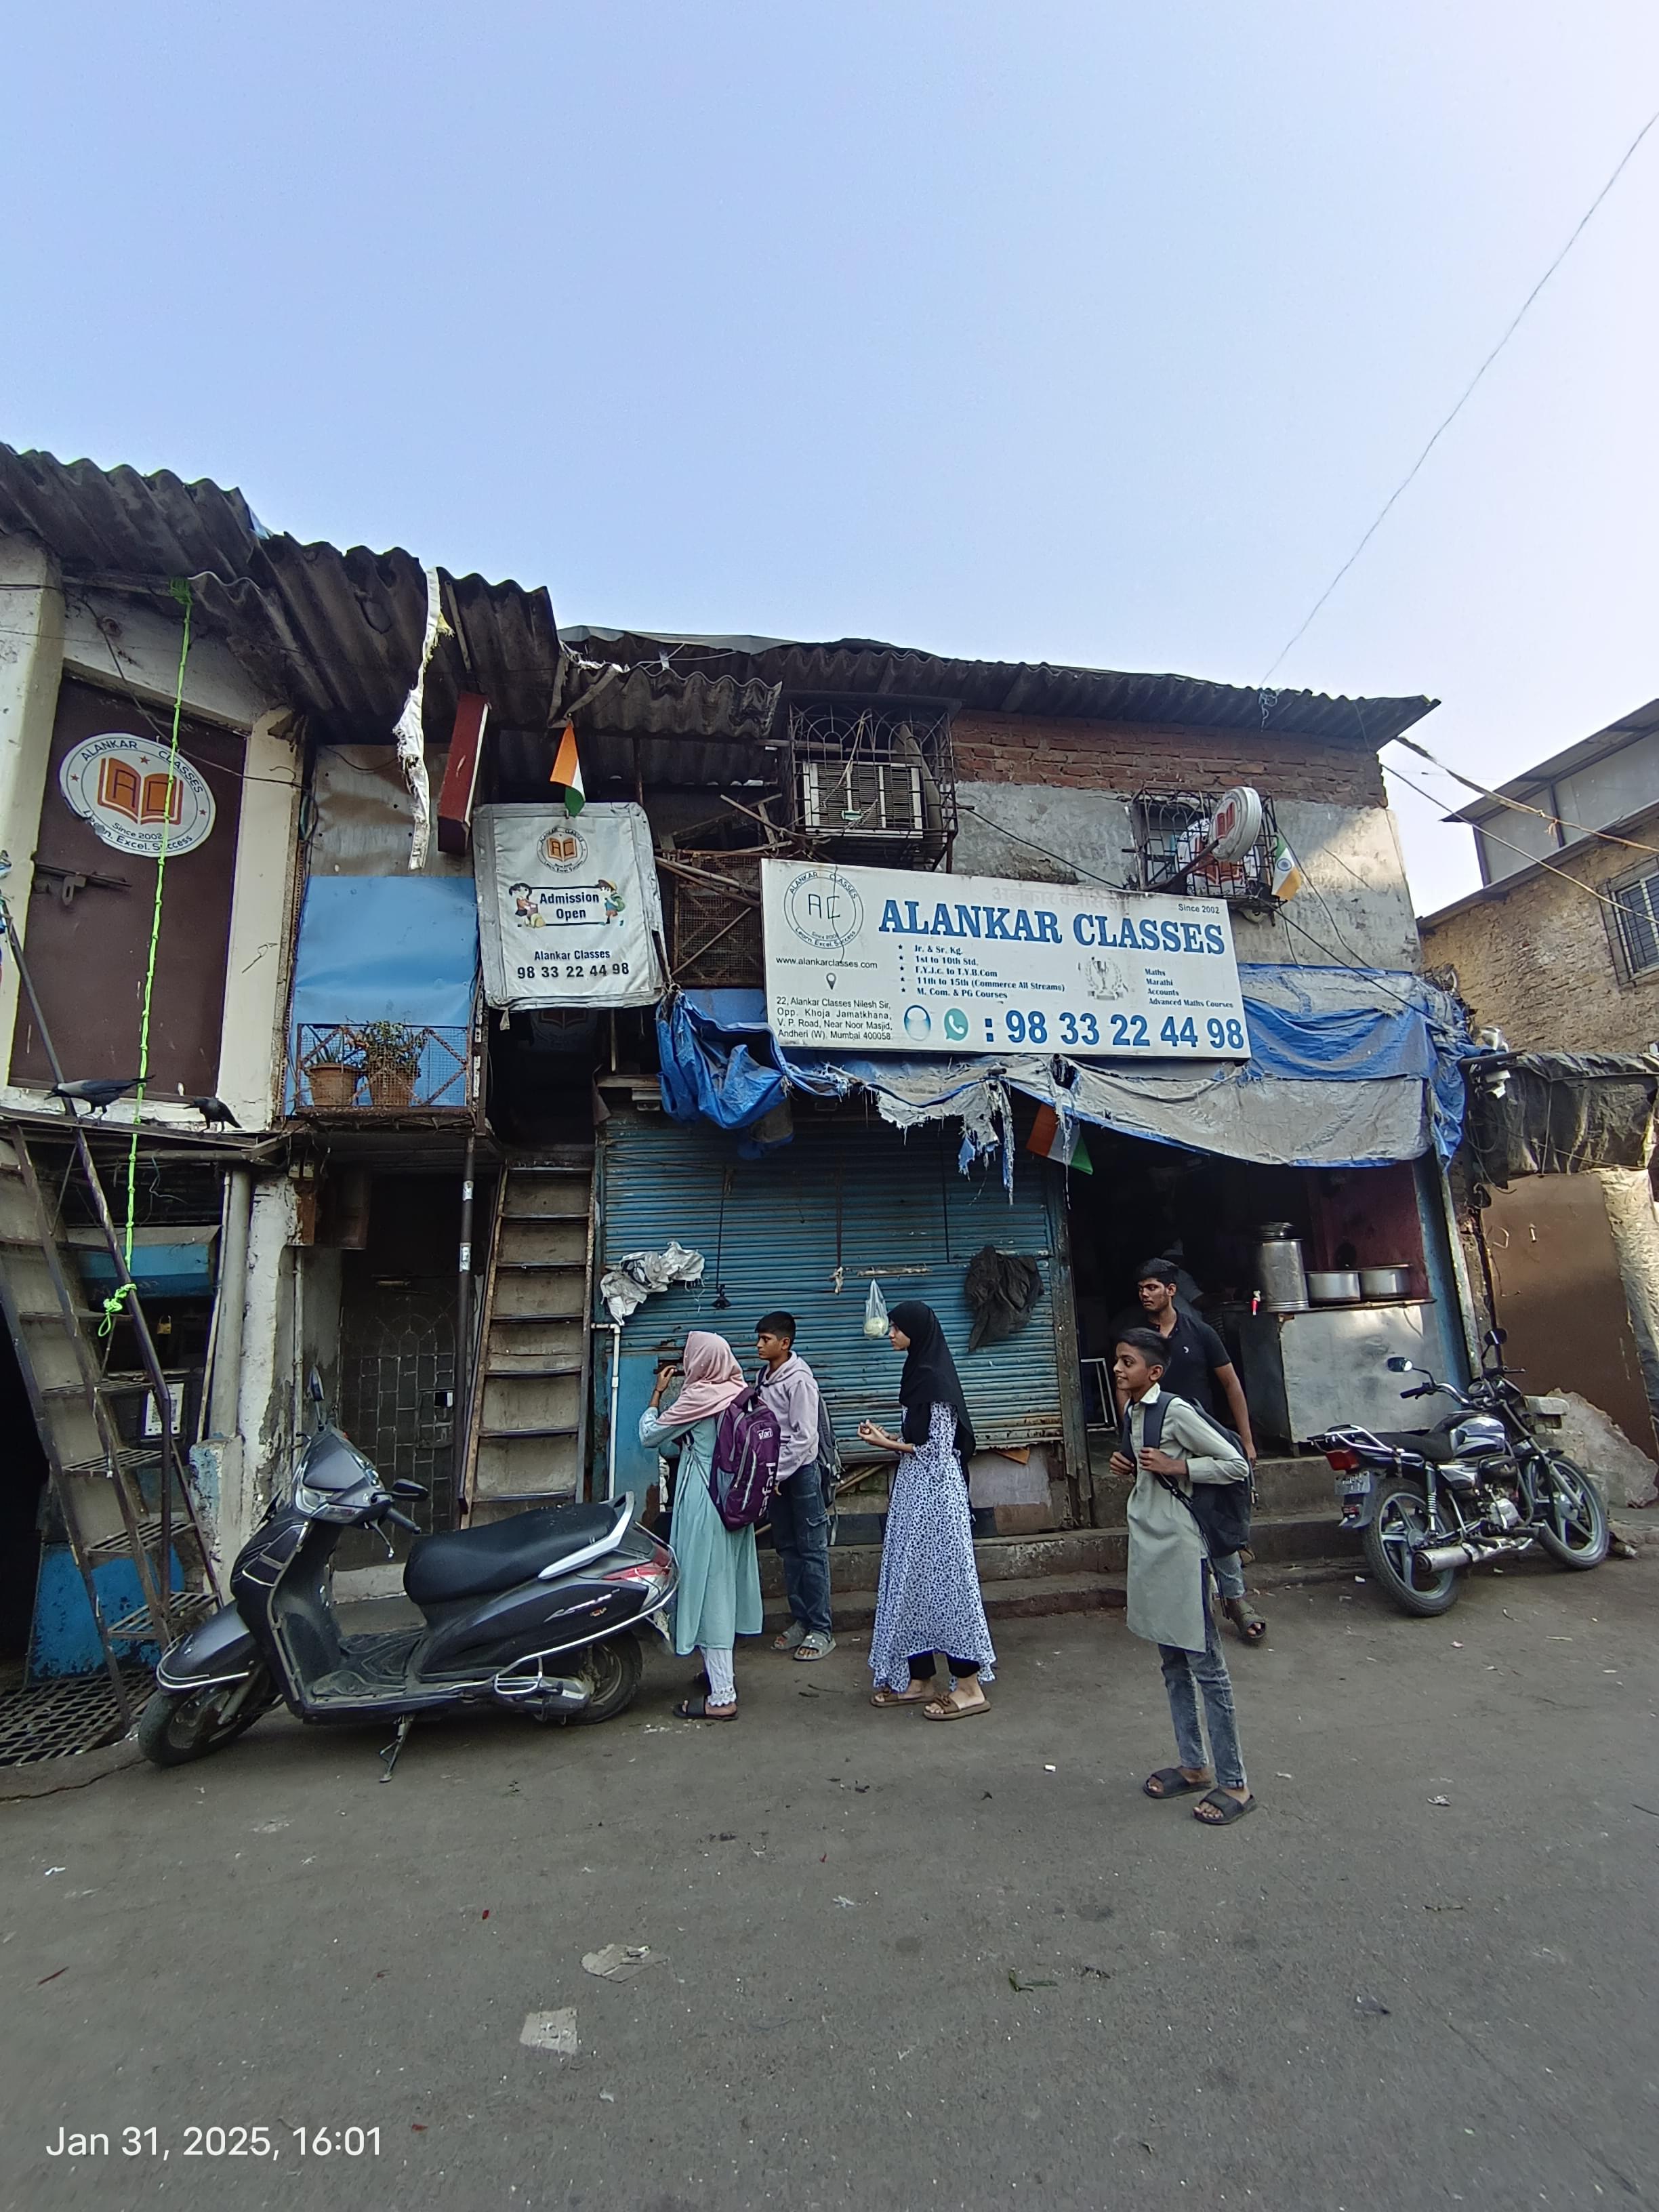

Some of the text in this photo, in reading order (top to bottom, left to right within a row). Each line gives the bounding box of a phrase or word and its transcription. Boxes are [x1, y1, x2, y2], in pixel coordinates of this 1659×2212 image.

[81, 740, 203, 793] ALANKAR CLASSES
[112, 822, 136, 837] Since
[117, 836, 150, 850] Excel.
[152, 836, 193, 851] Sccess
[539, 892, 600, 904] Admission
[1178, 903, 1220, 914] Since 2002
[556, 908, 586, 922] Open
[878, 899, 1225, 955] ALANKAR CLASSES
[534, 950, 610, 961] Alankar Classes
[915, 945, 924, 953] Jr.
[935, 946, 947, 954] Sr.
[776, 957, 878, 969] www.alankarclasses.com
[916, 956, 928, 964] 1st
[963, 958, 979, 966] Std.
[517, 962, 630, 979] 98 33 22 44 98
[1145, 968, 1166, 976] Maths
[918, 977, 935, 985] 11th
[950, 979, 968, 987] 15th
[971, 979, 1017, 989] (Commerce
[1146, 978, 1173, 986] Marathi
[917, 987, 926, 996] M.
[953, 989, 959, 997] &
[962, 989, 972, 998] PG
[976, 990, 1008, 999] Courses
[1148, 988, 1179, 996] Accounts
[776, 996, 789, 1006] 22,
[790, 997, 819, 1006] Alankar
[821, 998, 852, 1008] Classes
[854, 1000, 877, 1008] Nilesh
[1149, 998, 1182, 1006] Advanced
[1183, 999, 1204, 1007] Maths
[777, 1007, 892, 1021] Opp. Khoja Jamatkhana,
[777, 1018, 785, 1027] V.
[798, 1019, 821, 1029] Road,
[824, 1020, 842, 1028] Near
[845, 1021, 864, 1029] Noor
[866, 1021, 893, 1031] Masjid,
[1005, 1009, 1048, 1044] 98
[1059, 1012, 1100, 1046] 33
[1110, 1014, 1151, 1046] 22
[1160, 1017, 1198, 1048] 44
[1206, 1018, 1244, 1050] 98
[778, 1029, 808, 1038] Andheri
[830, 1031, 861, 1040] Mumbai
